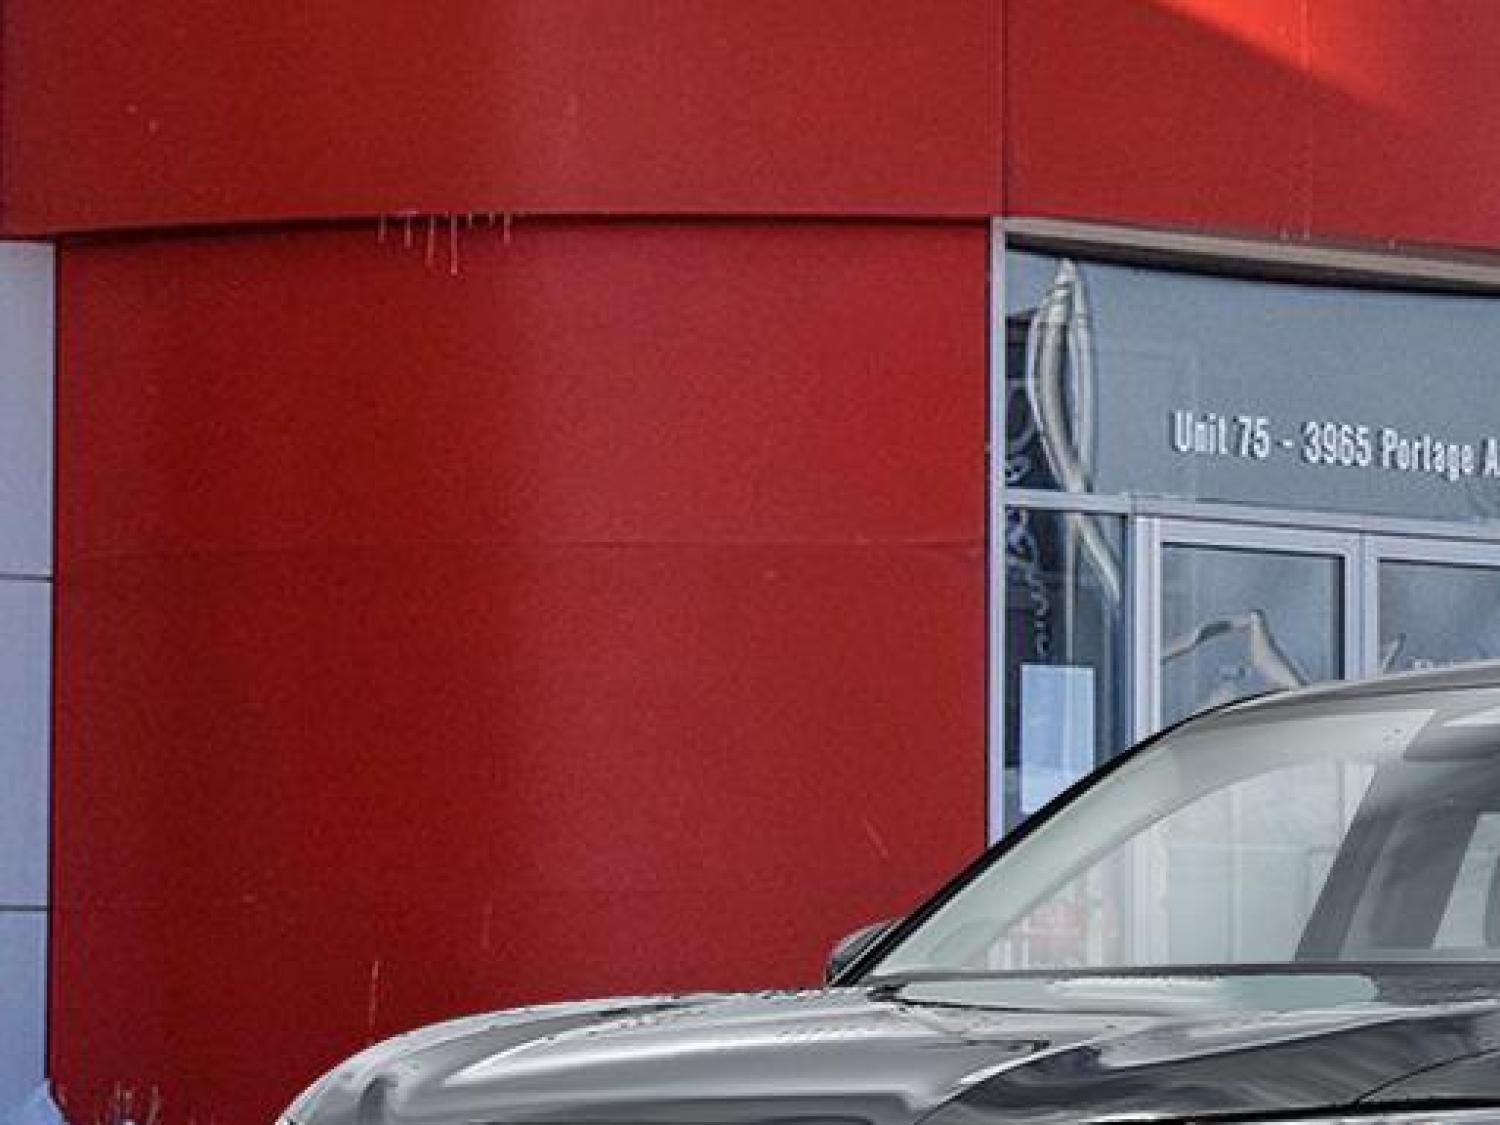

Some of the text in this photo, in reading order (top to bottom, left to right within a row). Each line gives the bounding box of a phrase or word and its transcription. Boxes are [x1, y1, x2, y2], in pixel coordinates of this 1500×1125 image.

[1173, 409, 1228, 455] Unit
[1237, 415, 1270, 459] 75
[1303, 421, 1372, 467] 3965
[1380, 426, 1474, 481] Portage
